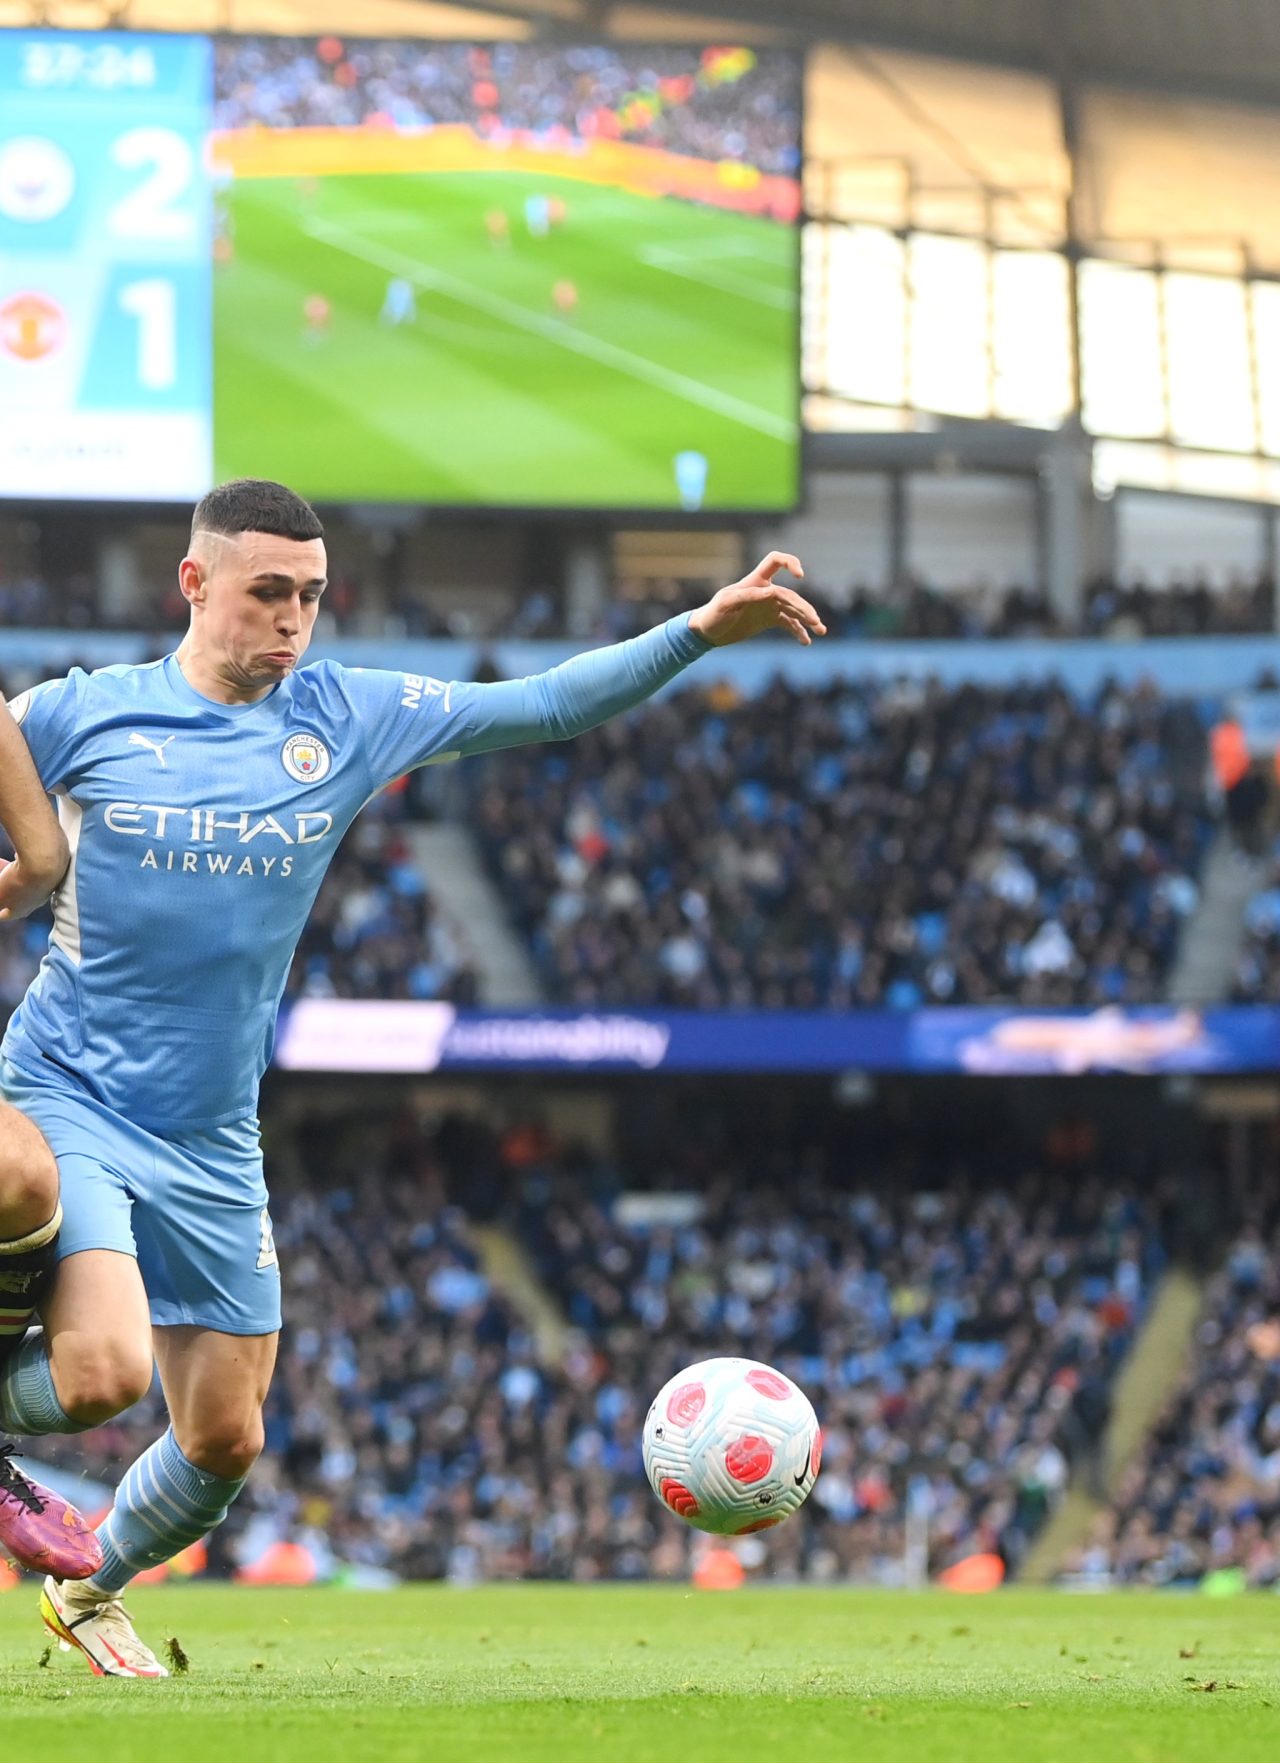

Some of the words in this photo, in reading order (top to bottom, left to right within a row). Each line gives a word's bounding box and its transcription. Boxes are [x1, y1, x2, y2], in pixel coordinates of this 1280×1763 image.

[109, 127, 199, 239] 2
[120, 279, 177, 390] 1
[104, 802, 333, 844] ETIHAD
[140, 849, 294, 877] AIRWAYS
